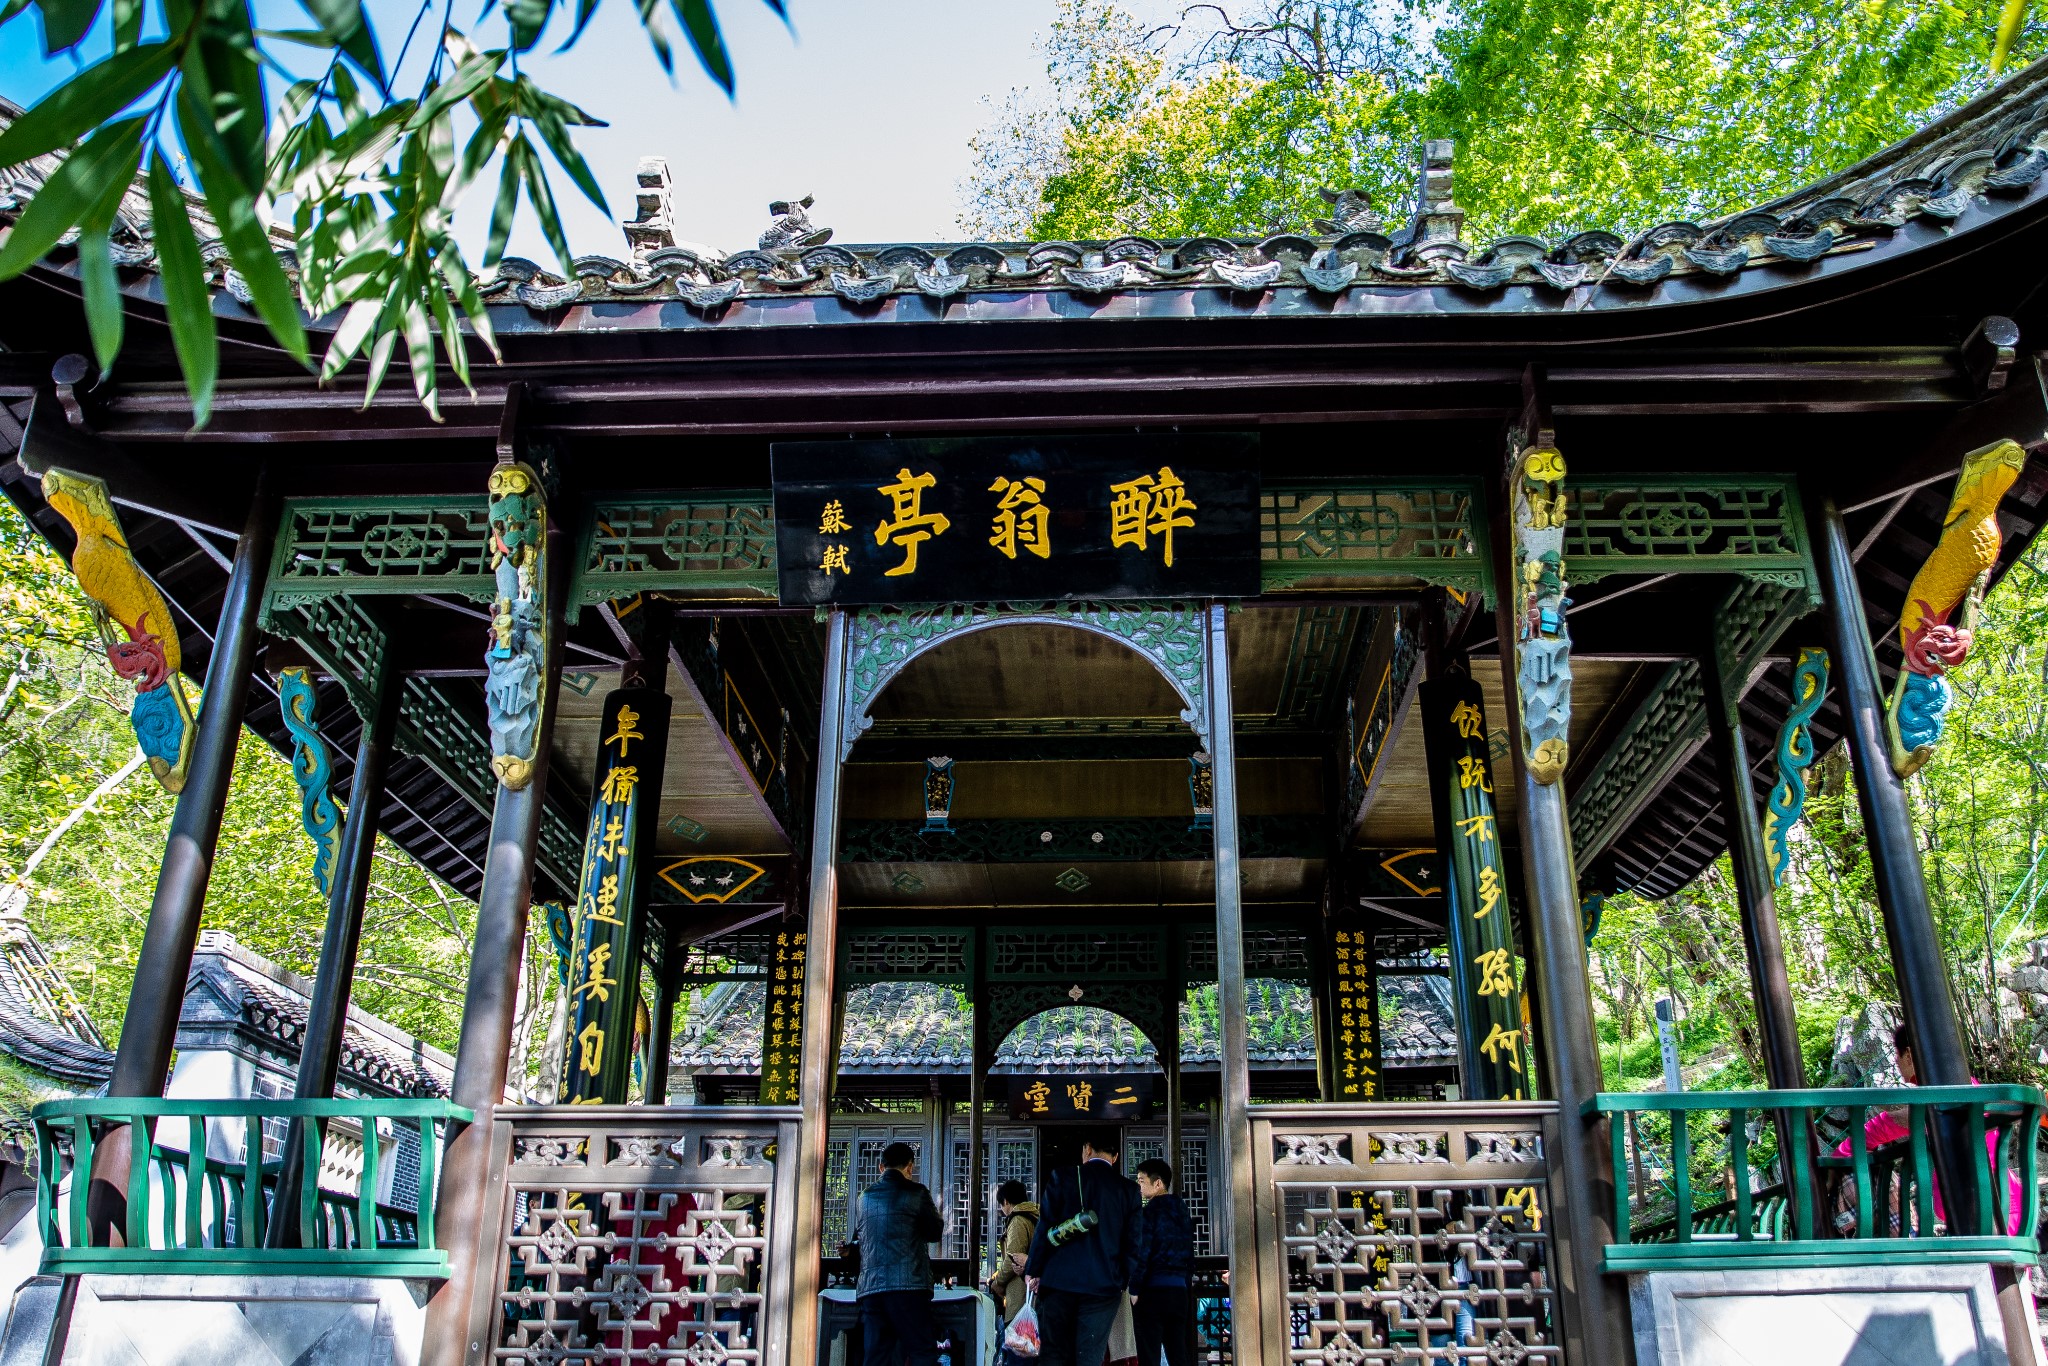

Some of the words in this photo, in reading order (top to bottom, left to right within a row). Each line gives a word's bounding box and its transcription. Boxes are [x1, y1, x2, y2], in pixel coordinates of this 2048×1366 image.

[818, 498, 853, 576] 蘇軾
[875, 466, 1198, 576] 醉翁亭
[1023, 1081, 1138, 1112] 二賢堂
